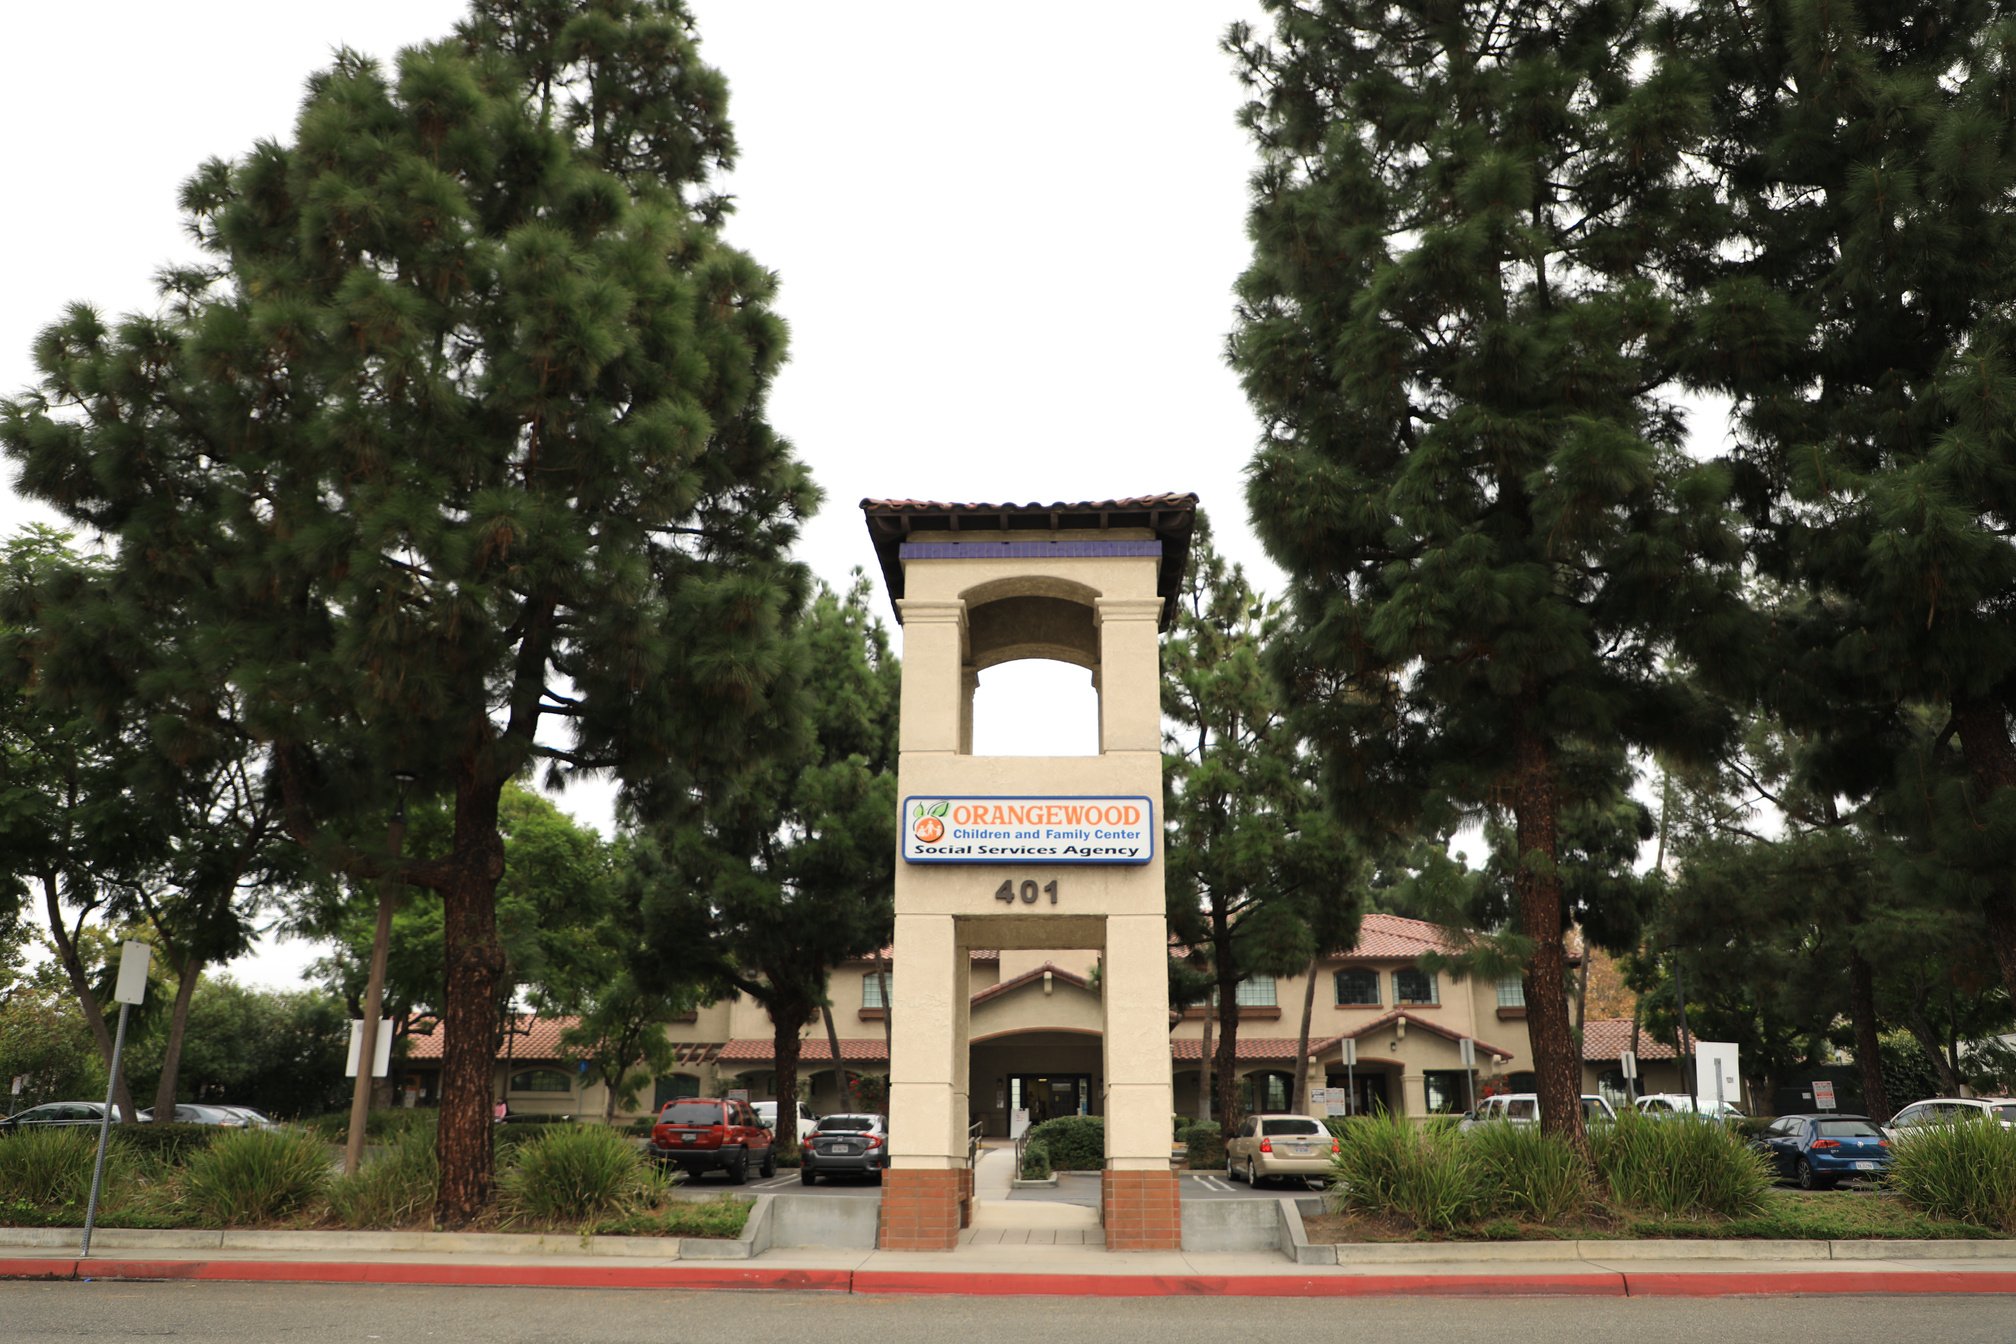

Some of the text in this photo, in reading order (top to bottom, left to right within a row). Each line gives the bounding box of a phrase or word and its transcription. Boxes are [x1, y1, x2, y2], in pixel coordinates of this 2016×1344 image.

[953, 805, 1141, 826] ORANGEWOOD
[953, 829, 1141, 841] Children and Family Center
[914, 845, 1139, 857] Social Services Agency
[995, 880, 1058, 904] 401
